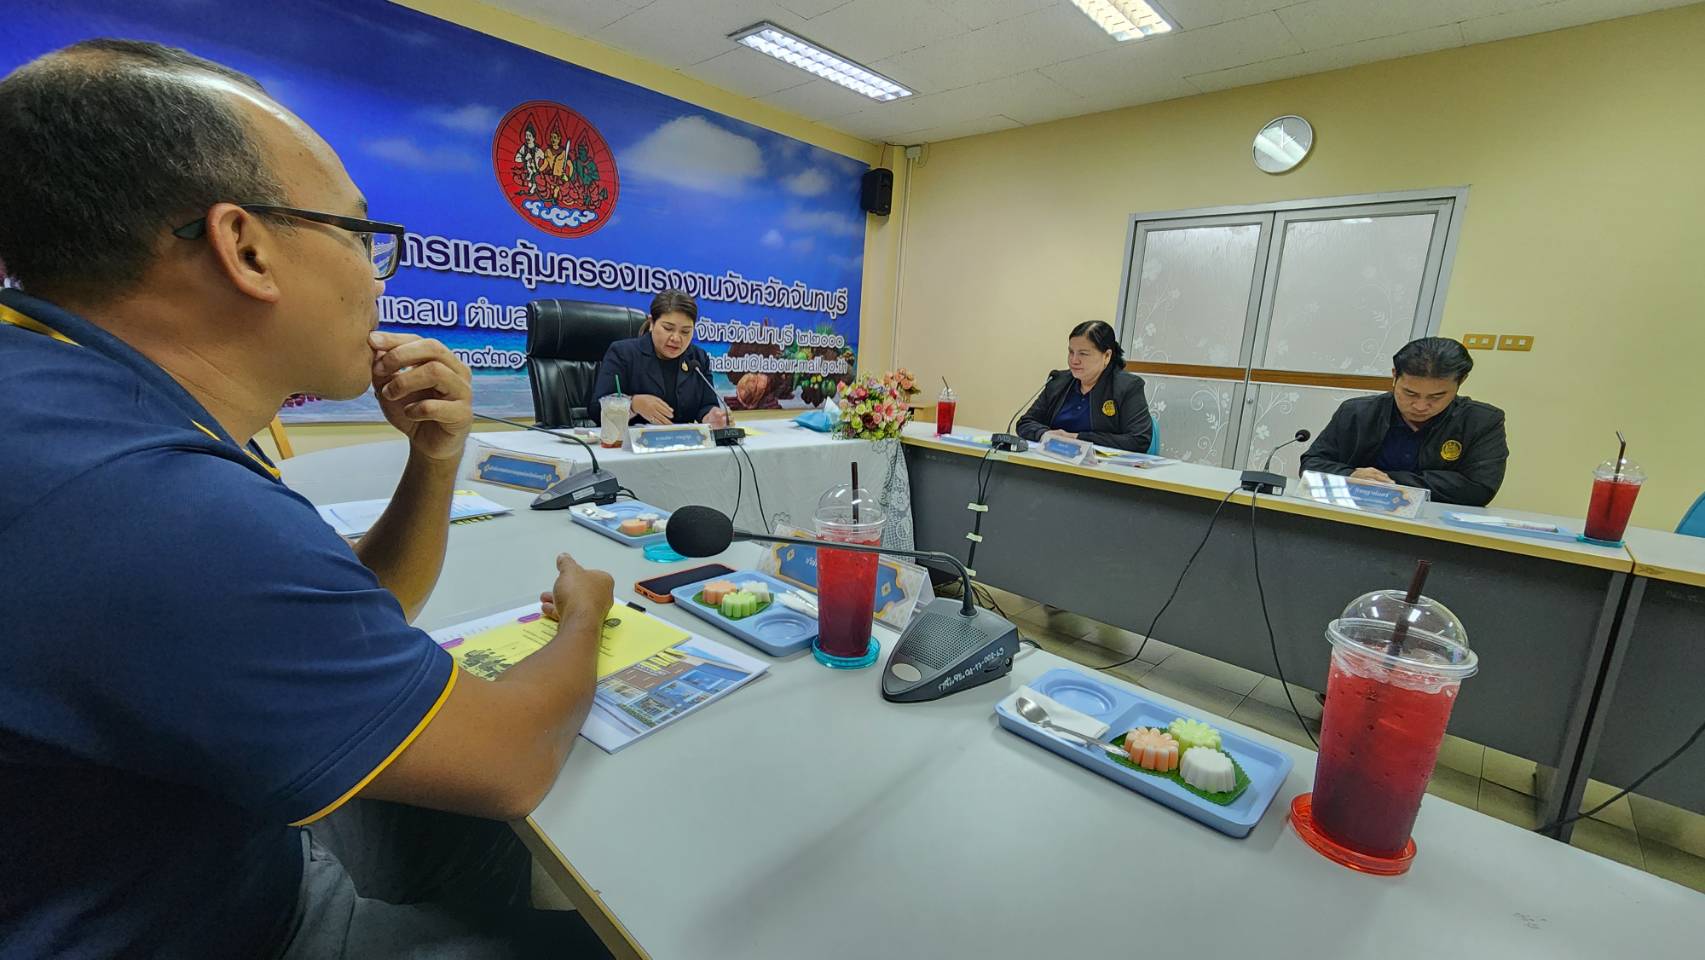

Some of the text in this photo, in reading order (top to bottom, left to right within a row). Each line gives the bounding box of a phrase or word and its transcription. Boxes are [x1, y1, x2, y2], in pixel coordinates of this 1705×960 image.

[378, 297, 457, 326] แฉลบ
[696, 317, 794, 350] จังหวัดจันทบุรี
[796, 330, 844, 348] ๒๒๐๐๐
